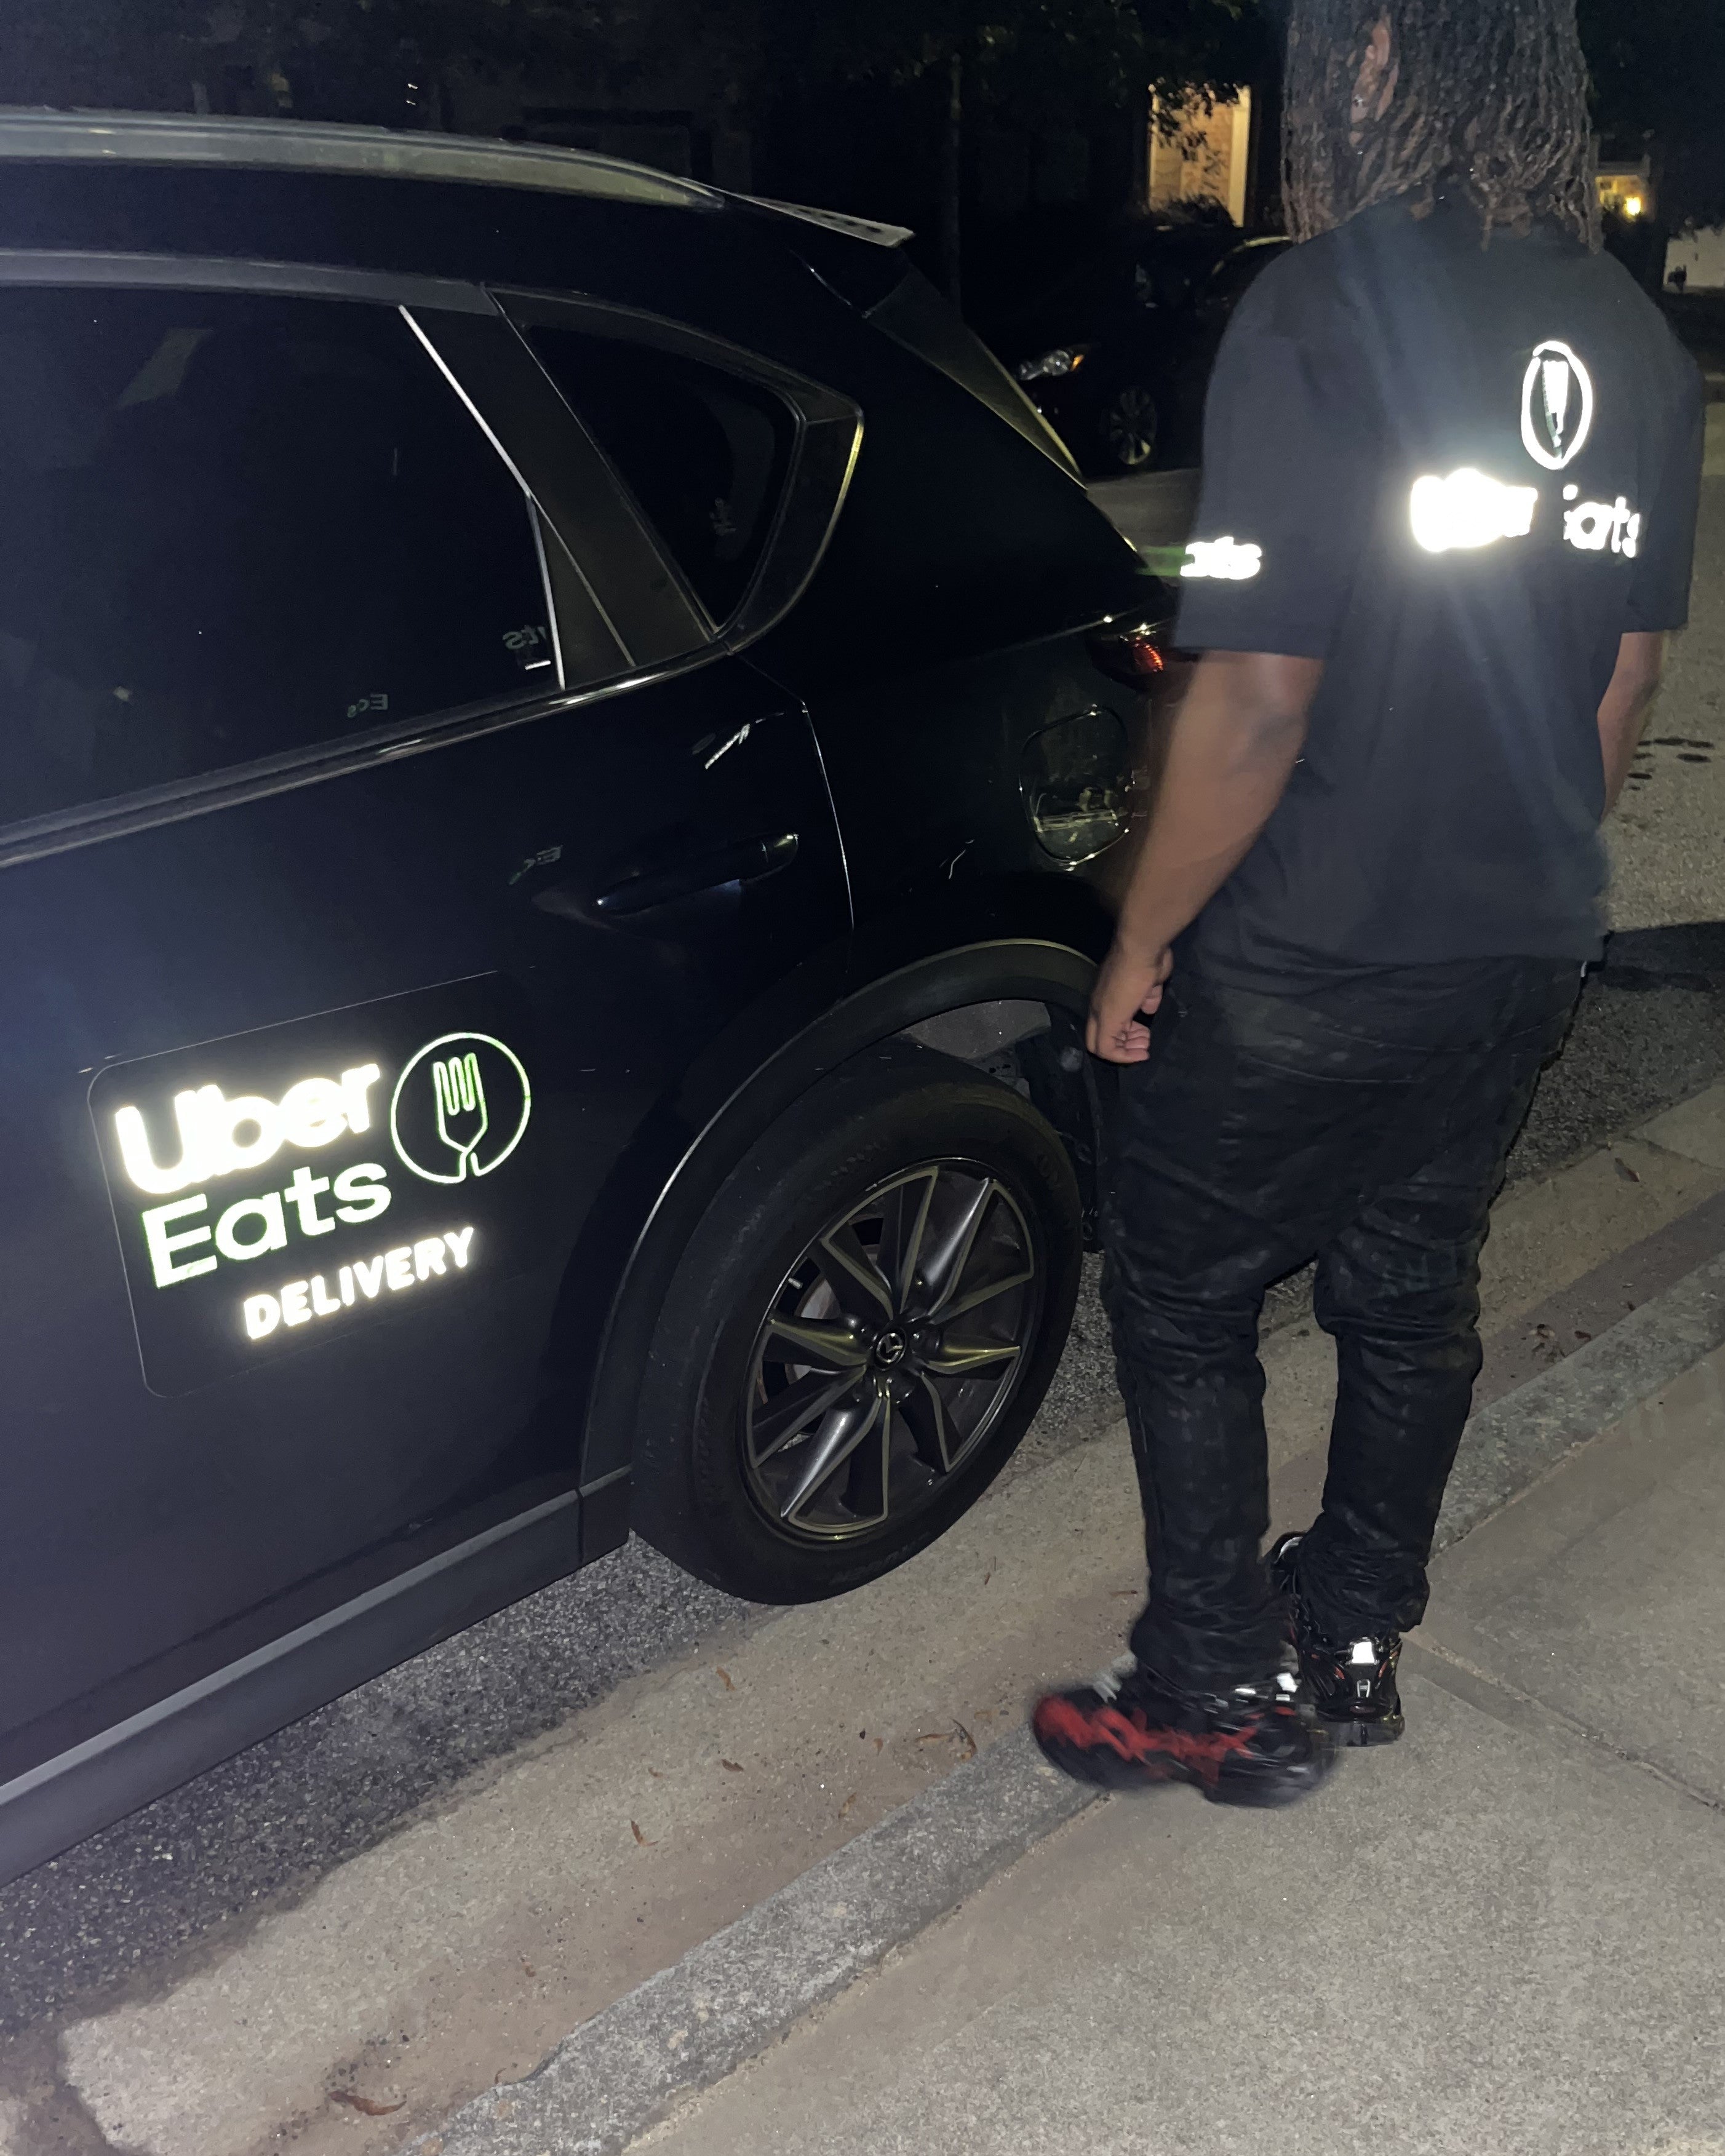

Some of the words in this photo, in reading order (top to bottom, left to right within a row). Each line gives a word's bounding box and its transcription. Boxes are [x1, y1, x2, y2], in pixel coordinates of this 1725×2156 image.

[114, 1063, 381, 1195] Uber
[141, 1163, 392, 1289] Eats
[242, 1226, 474, 1340] DELIVERY
